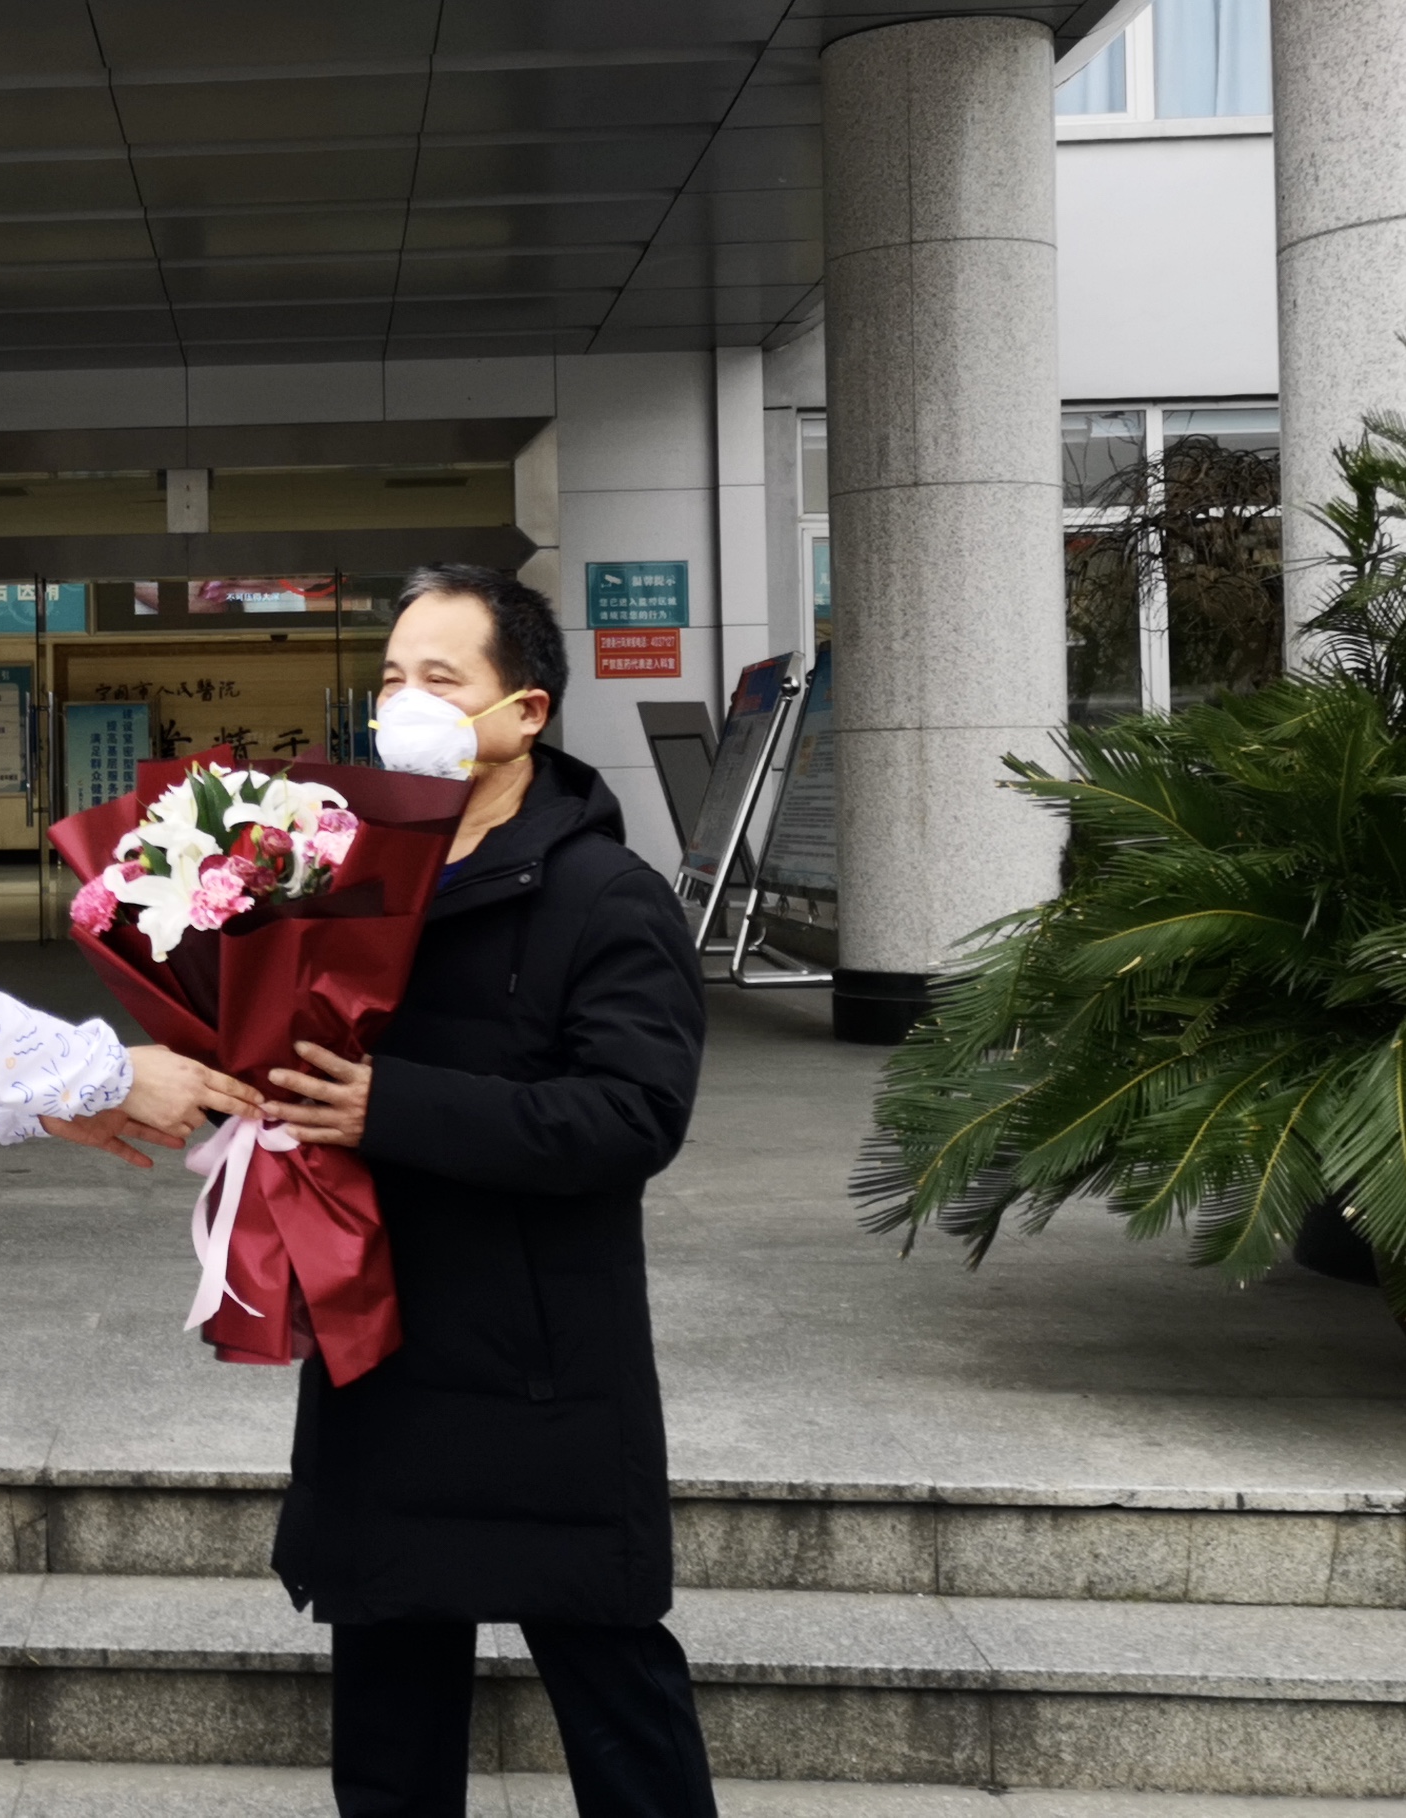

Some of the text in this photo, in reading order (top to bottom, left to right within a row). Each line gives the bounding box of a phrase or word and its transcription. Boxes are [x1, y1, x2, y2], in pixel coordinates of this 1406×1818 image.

[632, 575, 676, 587] 温馨提示
[599, 596, 677, 607] 您已进入监控区域
[602, 658, 676, 671] 严禁医药代表进入科室
